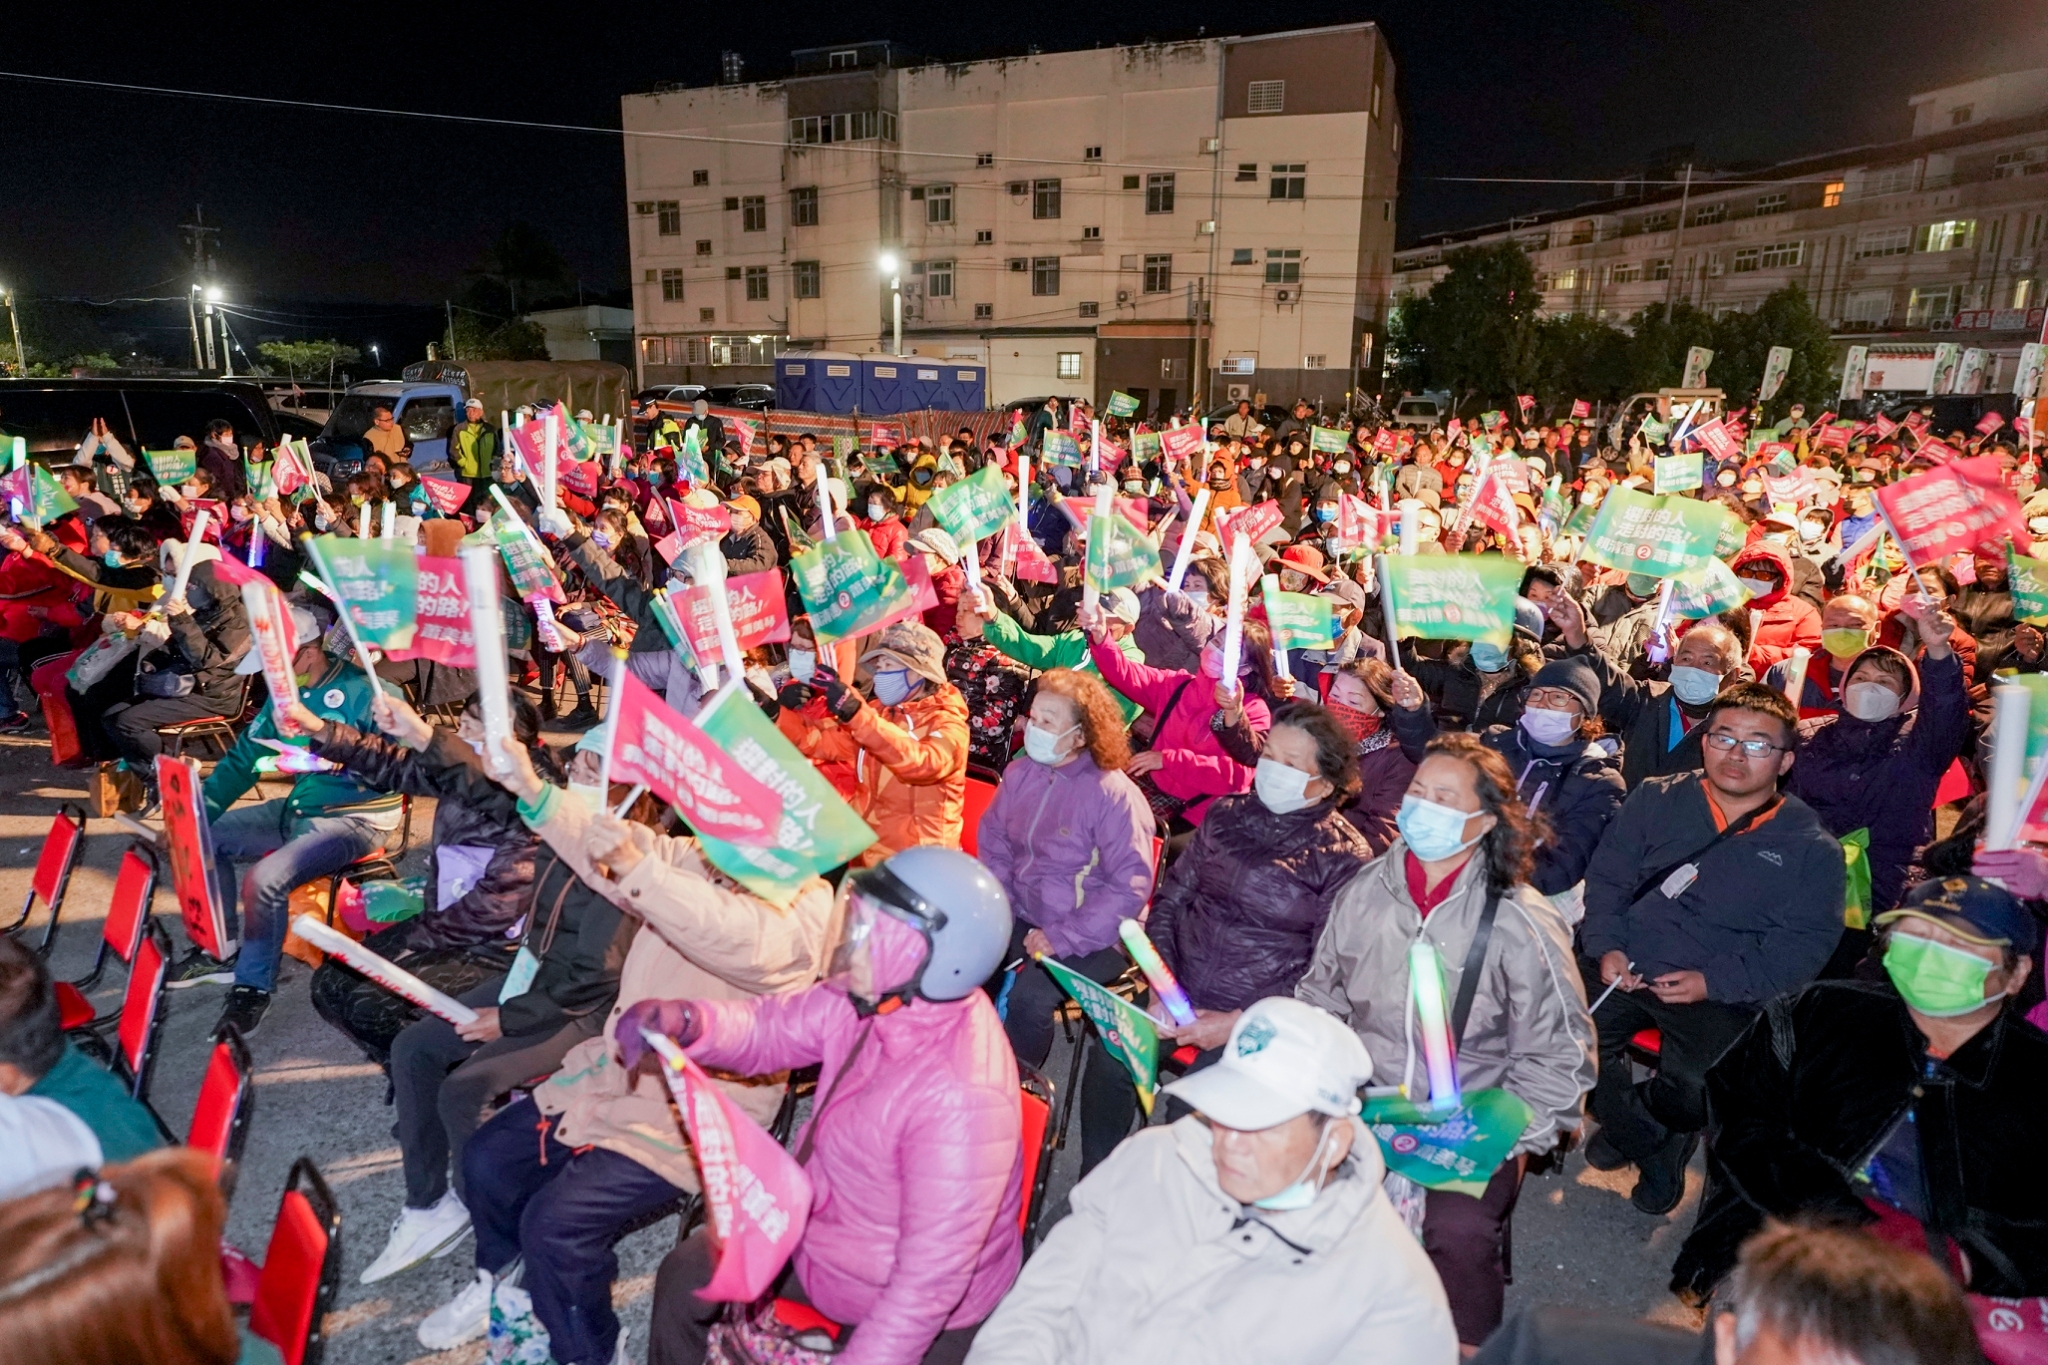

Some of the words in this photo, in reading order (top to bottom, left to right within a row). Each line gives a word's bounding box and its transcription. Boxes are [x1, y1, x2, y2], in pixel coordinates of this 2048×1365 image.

[1623, 505, 1687, 527] 選對的人
[1615, 522, 1691, 545] 走對的路!
[692, 585, 756, 616] 選的人
[697, 600, 763, 633] 走的路!
[732, 737, 822, 830] 選對的人
